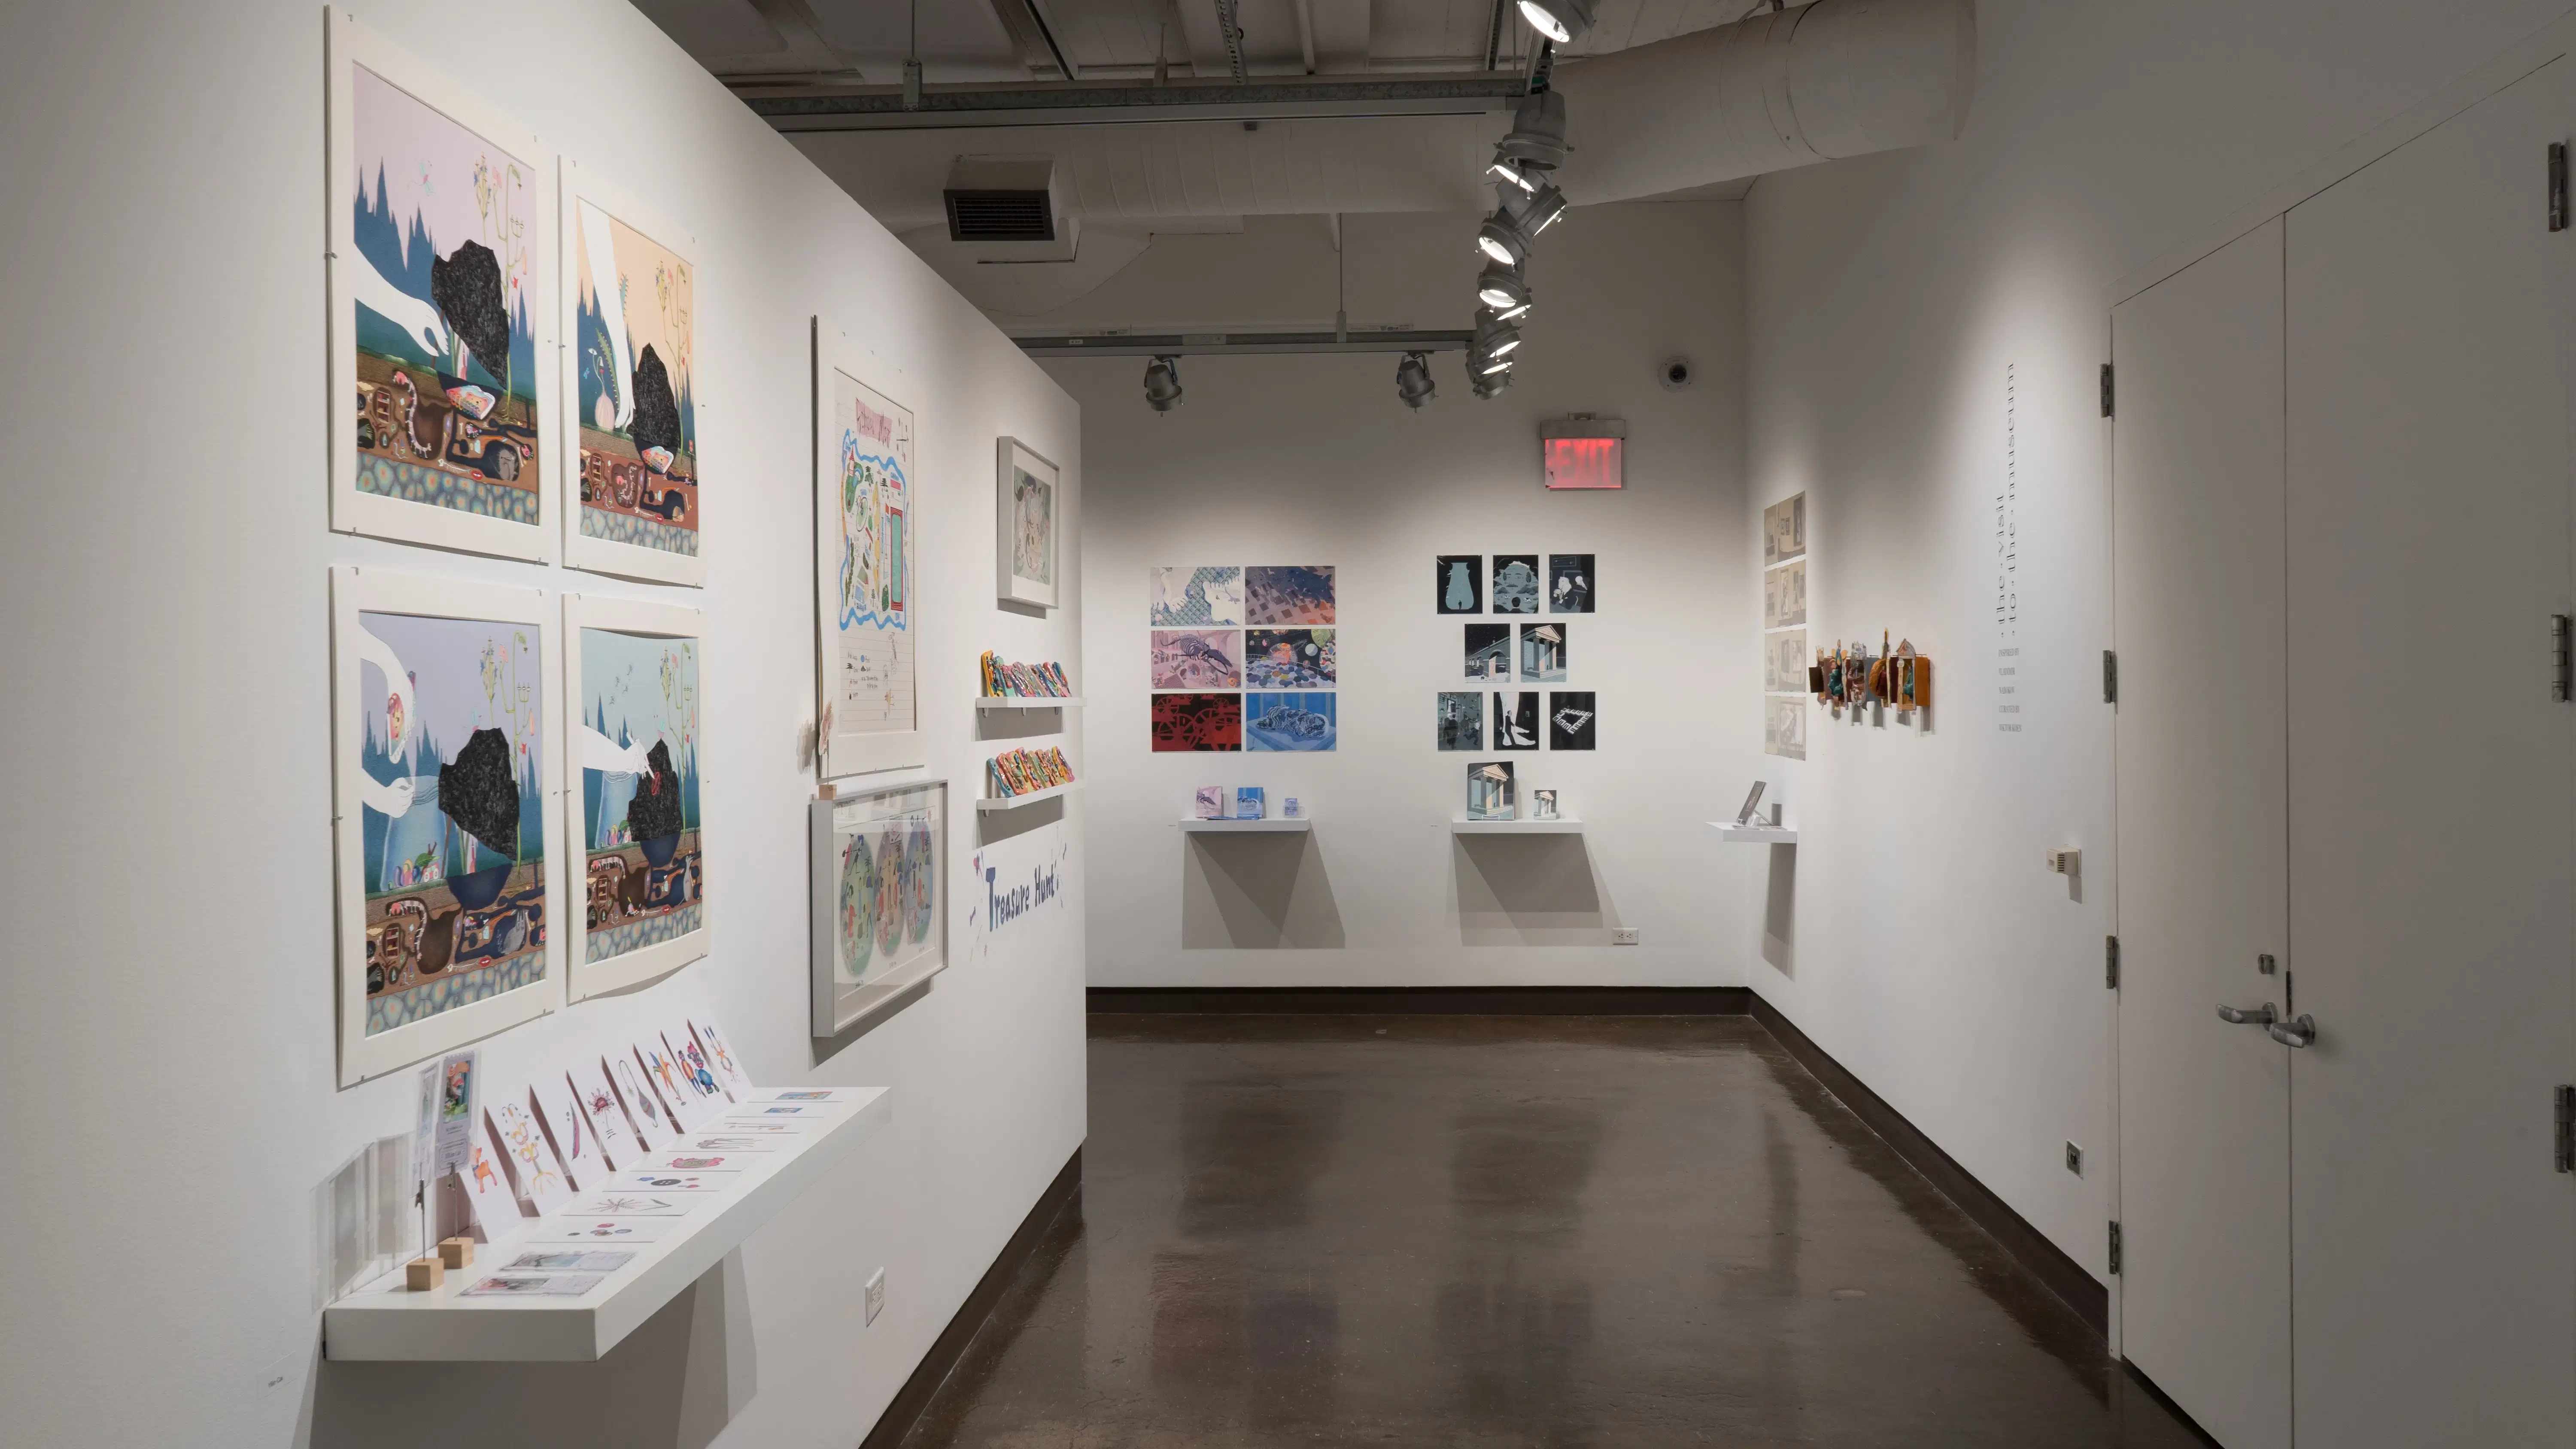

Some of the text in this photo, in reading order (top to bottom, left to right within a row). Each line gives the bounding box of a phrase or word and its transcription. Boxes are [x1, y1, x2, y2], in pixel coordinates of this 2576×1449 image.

[1555, 439, 1614, 485] EXIT
[2007, 362, 2015, 501] museum
[1996, 493, 2004, 558] visit
[986, 864, 1054, 933] Treasure Hunt
